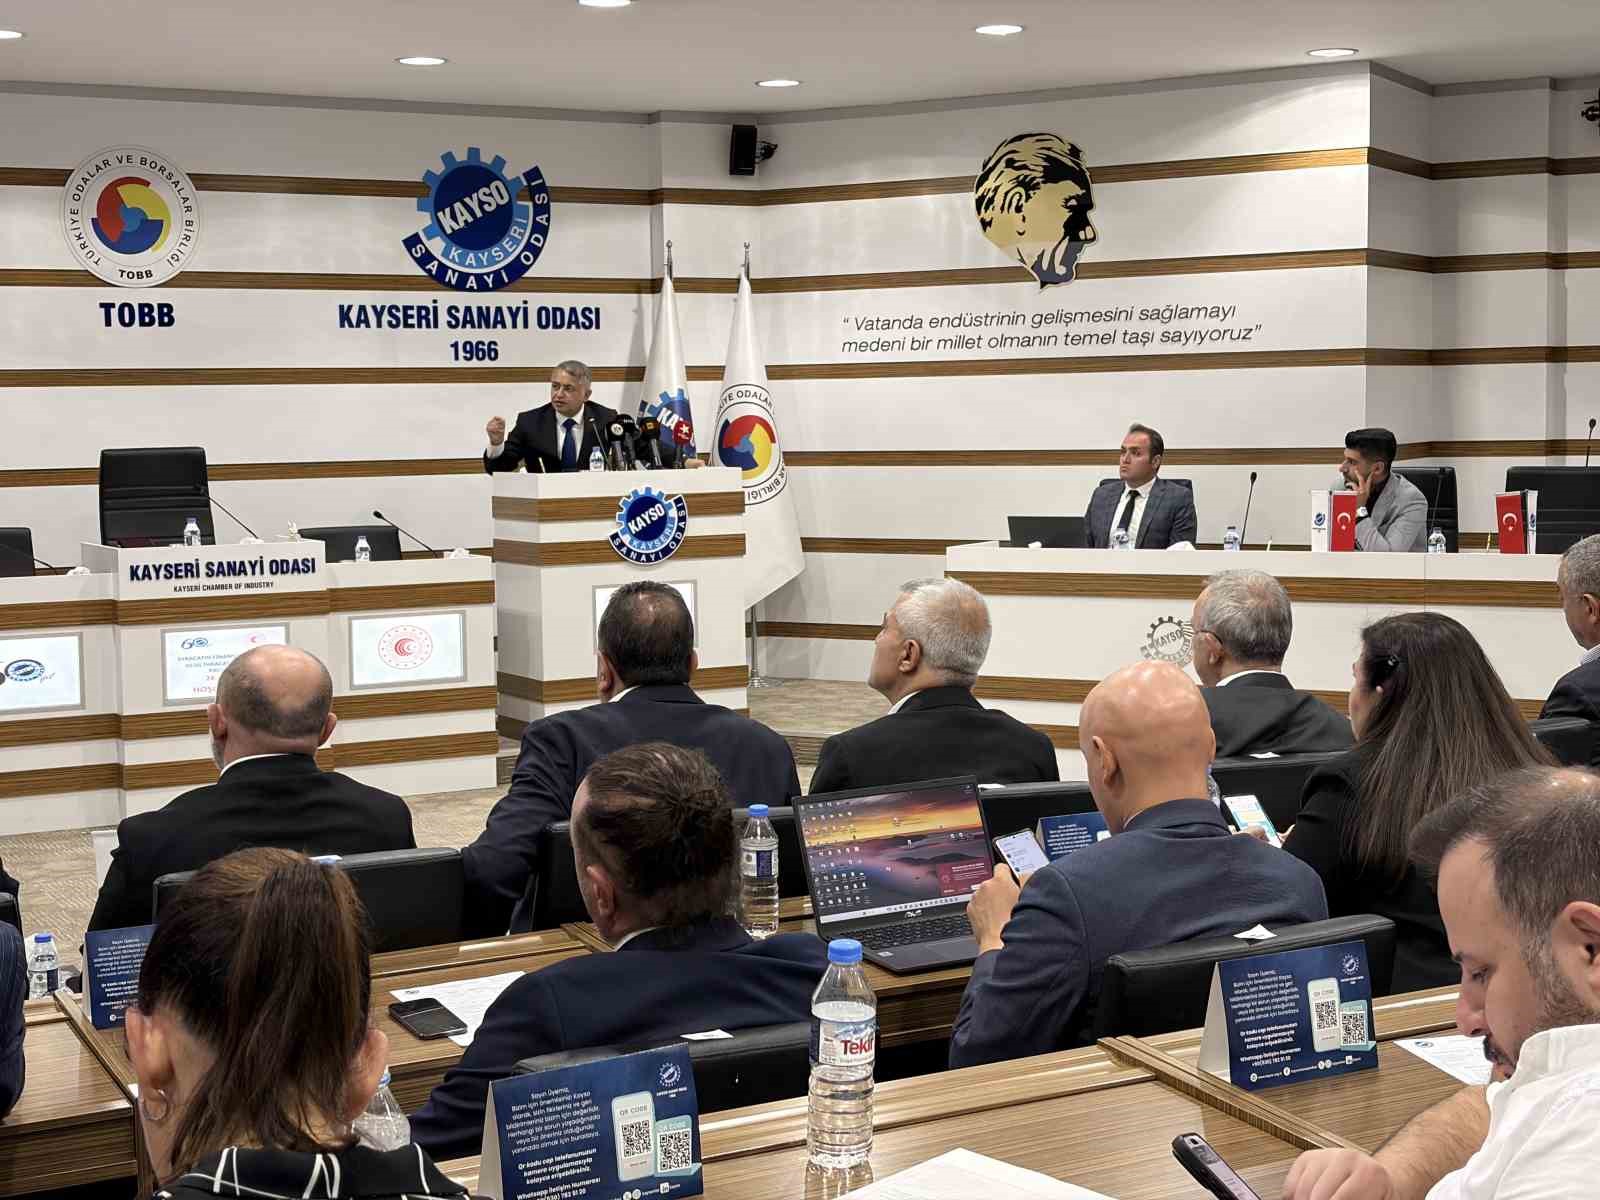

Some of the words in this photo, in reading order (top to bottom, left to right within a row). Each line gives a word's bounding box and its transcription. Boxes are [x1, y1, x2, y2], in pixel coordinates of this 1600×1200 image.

[72, 158, 112, 202] ODALAR
[116, 154, 134, 164] VE
[139, 156, 193, 214] BORSALAR
[437, 180, 510, 235] KAYSO
[519, 179, 549, 266] ODASI
[118, 269, 153, 280] TOBB
[99, 302, 176, 328] TOBB
[338, 299, 439, 329] KAYSERİ
[446, 299, 529, 330] SANAYİ
[536, 306, 601, 331] ODASI
[854, 315, 923, 331] Vatanda
[928, 311, 1026, 329] endüstrinin
[1031, 306, 1134, 329] gelişmesini
[1138, 303, 1236, 324] sağlamayı
[450, 340, 499, 362] 1966
[842, 336, 906, 353] medeni
[910, 336, 932, 351] bir
[937, 335, 983, 350] millet
[987, 333, 1058, 349] olmanın
[1063, 329, 1117, 346] temel
[1122, 329, 1155, 347] taşı
[628, 503, 665, 535] KAYSO
[129, 559, 200, 581] KAYSERİ
[205, 556, 265, 578] SANAYİ
[269, 557, 316, 576] ODASI
[202, 583, 233, 592] CHAMBER
